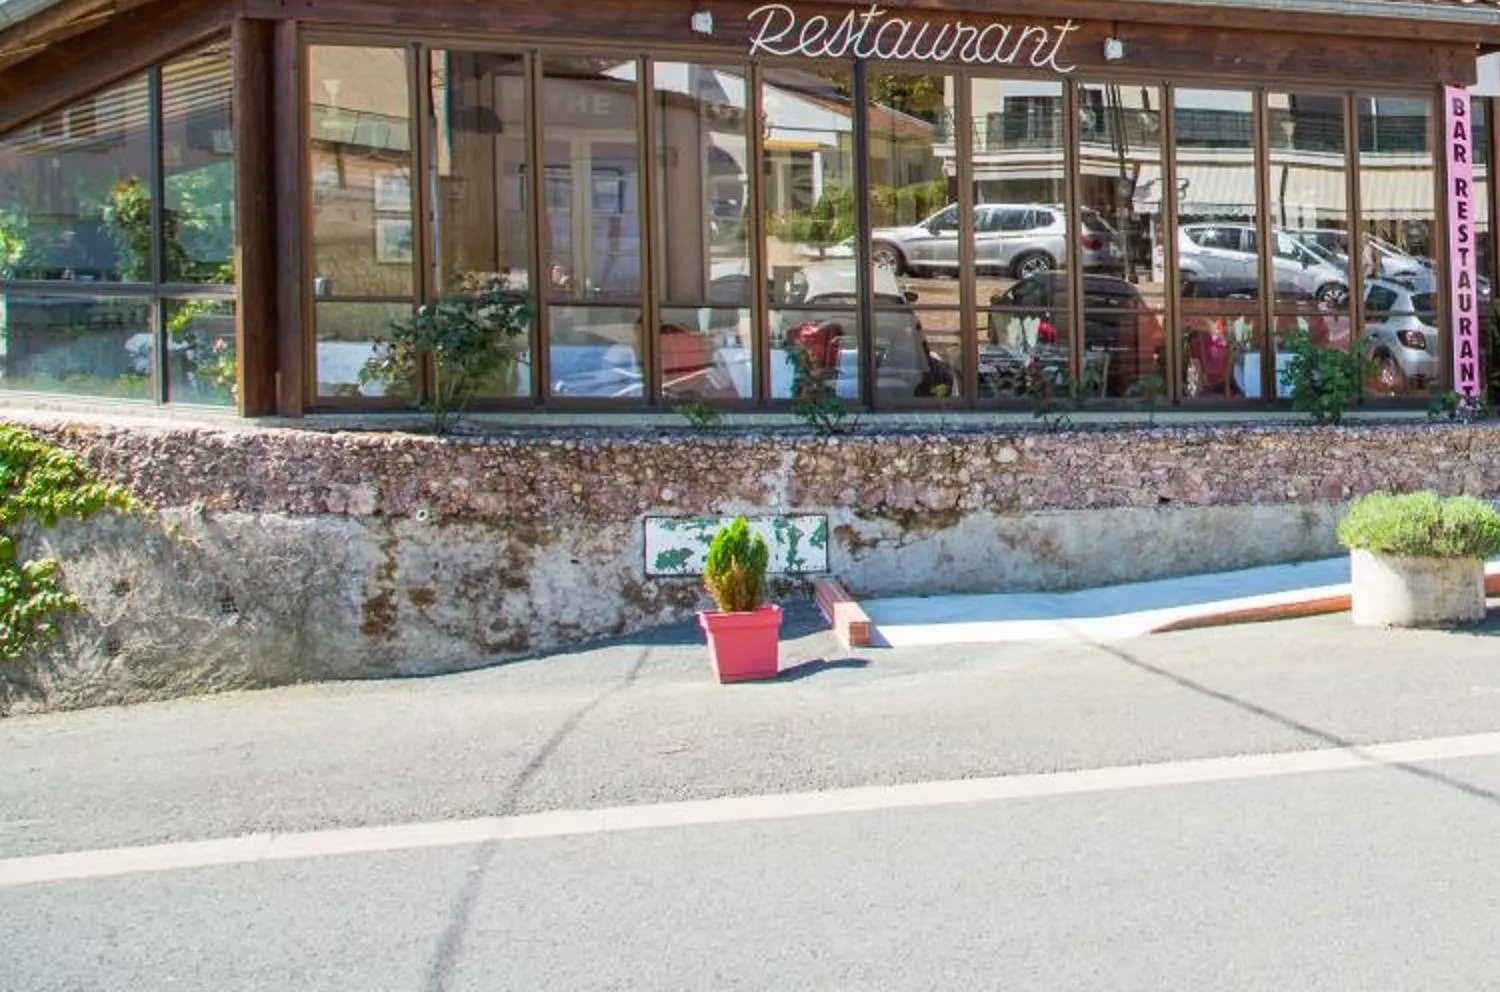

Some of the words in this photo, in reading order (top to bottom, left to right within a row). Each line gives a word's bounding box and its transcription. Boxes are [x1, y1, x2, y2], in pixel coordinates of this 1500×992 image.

[746, 2, 1081, 73] Restaurant
[1452, 97, 1468, 163] BAR
[1455, 178, 1476, 398] RESTAURANT
